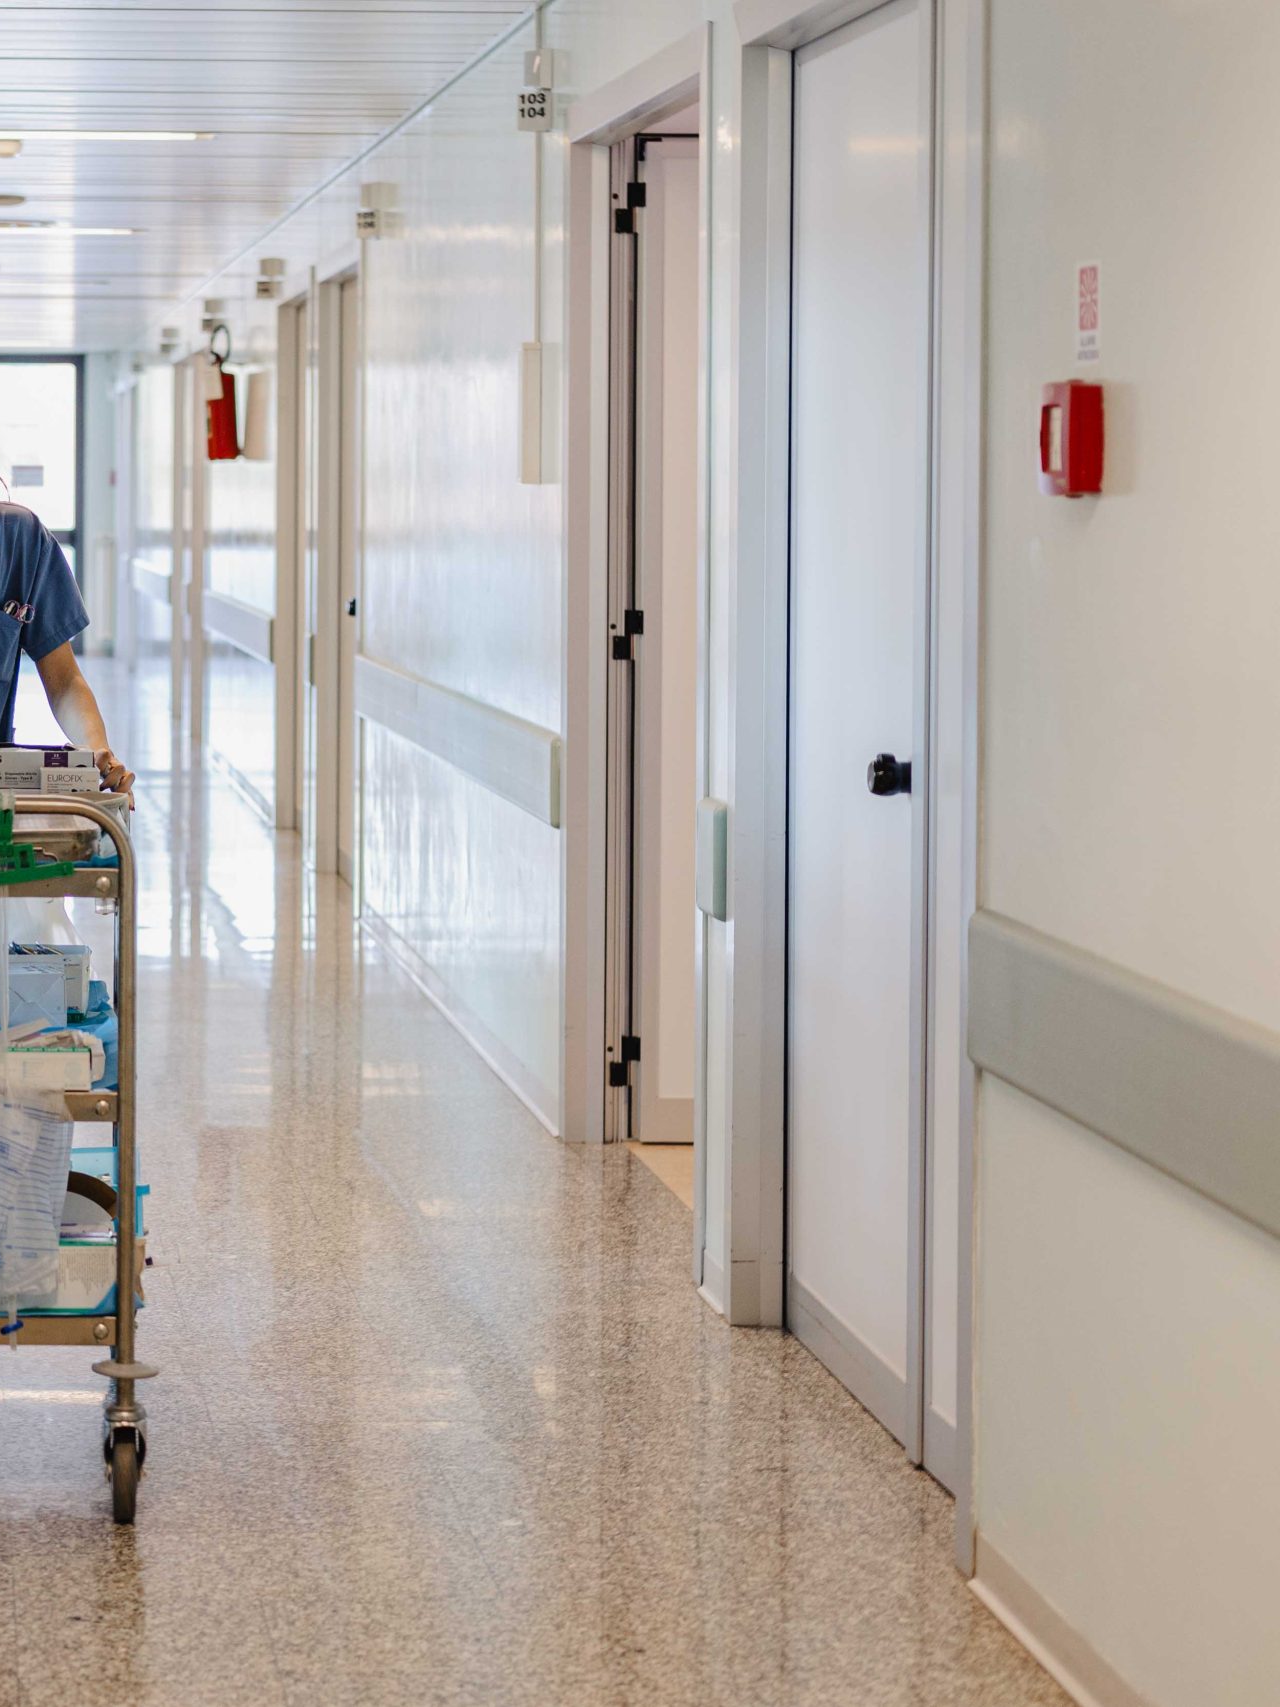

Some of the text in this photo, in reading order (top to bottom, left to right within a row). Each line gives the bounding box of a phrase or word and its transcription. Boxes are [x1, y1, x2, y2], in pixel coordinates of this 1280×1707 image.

[519, 93, 546, 104] 103
[519, 107, 545, 118] 104
[47, 774, 83, 783] EUROFIX
